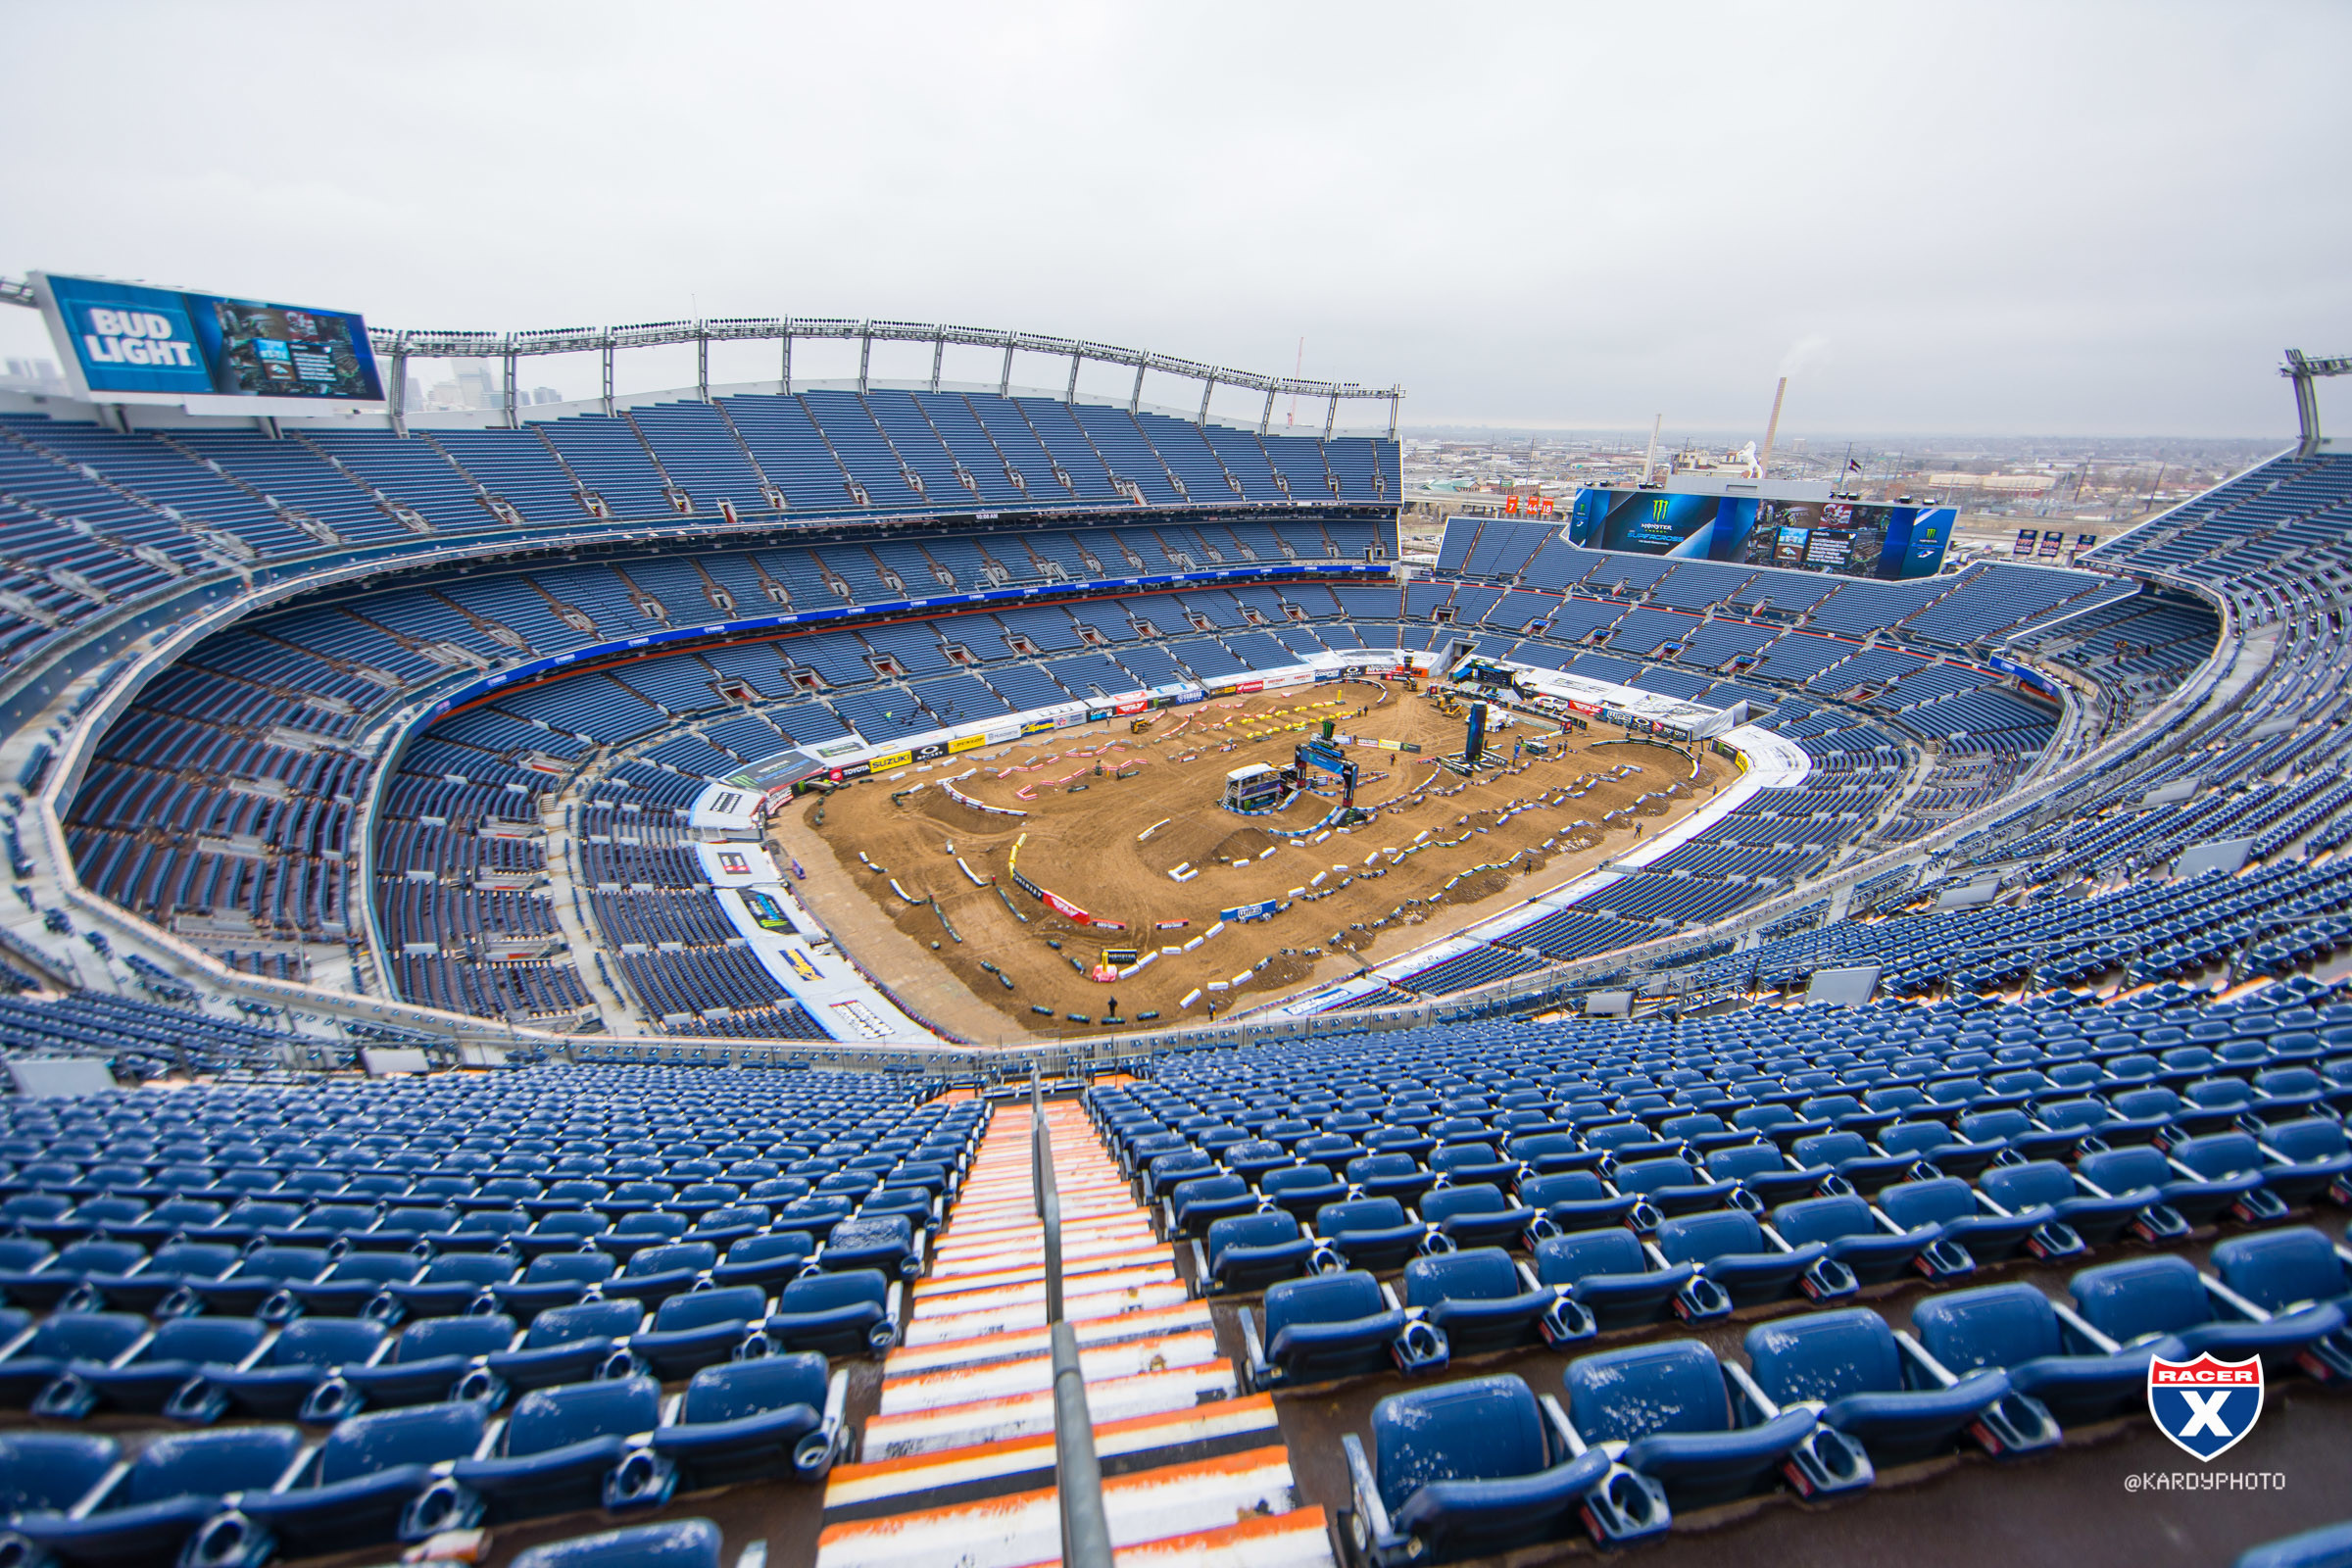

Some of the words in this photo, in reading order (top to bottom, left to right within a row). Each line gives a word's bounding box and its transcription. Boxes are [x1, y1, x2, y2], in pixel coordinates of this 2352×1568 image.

[87, 308, 172, 340] BUD
[83, 334, 194, 367] LIGHT
[1641, 522, 1673, 531] MONSTER
[1090, 708, 1112, 716] GoPro
[1607, 710, 1632, 722] WPS
[1664, 727, 1687, 737] TOOTA
[871, 754, 910, 769] SUZUKI
[843, 764, 870, 776] TOYOTA
[1238, 906, 1262, 918] WPS
